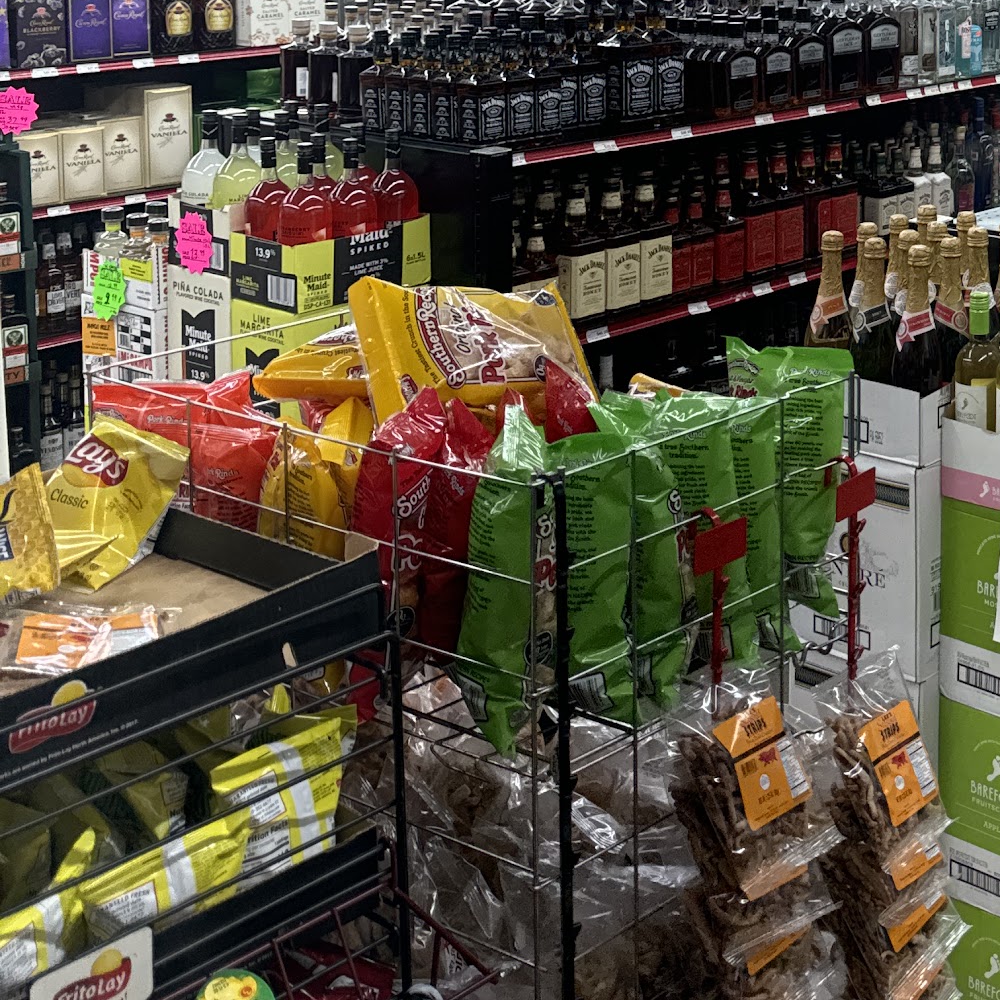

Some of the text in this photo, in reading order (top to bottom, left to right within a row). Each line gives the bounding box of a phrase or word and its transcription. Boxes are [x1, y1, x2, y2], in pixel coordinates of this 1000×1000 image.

[151, 129, 188, 138] VANILLA
[105, 148, 138, 157] VANILLA
[66, 159, 101, 168] VANILLA
[350, 242, 389, 256] SPIKED
[303, 272, 331, 284] Minute
[173, 281, 224, 300] PIÑA COLADA
[307, 281, 329, 292] Maid
[253, 314, 270, 325] LIME
[185, 325, 212, 340] Minute
[407, 323, 418, 348] Crunch
[425, 322, 467, 389] Southern
[64, 441, 126, 480] Lay's
[51, 488, 89, 509] Classic
[745, 718, 767, 736] STRIPS
[881, 723, 900, 742] STRIPS
